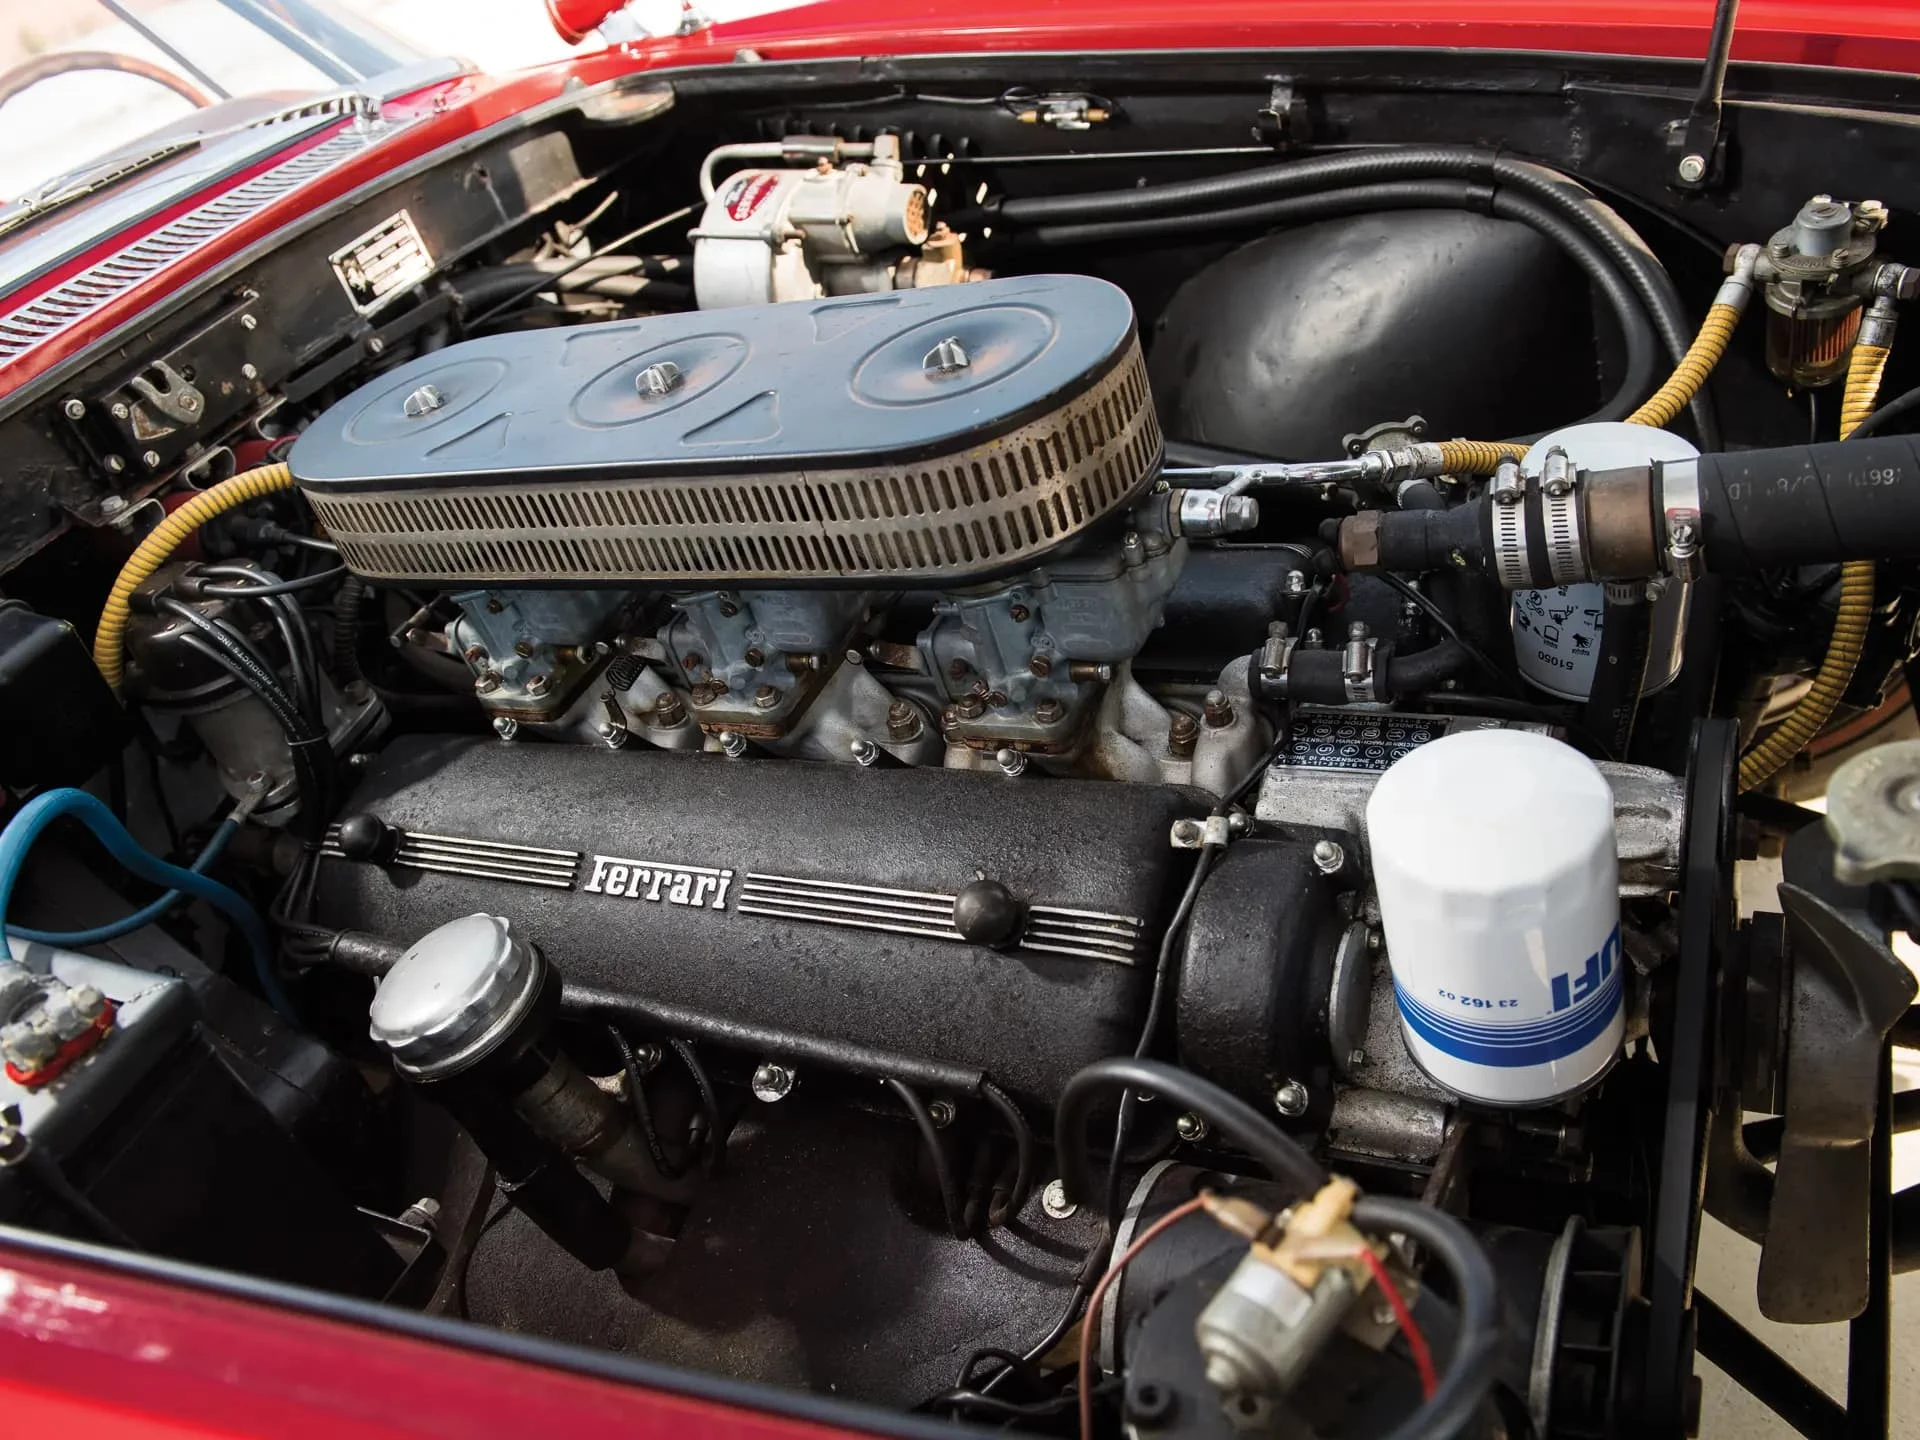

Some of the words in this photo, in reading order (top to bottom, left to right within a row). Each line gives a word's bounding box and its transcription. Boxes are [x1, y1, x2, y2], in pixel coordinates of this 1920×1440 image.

[232, 646, 274, 686] PRODUCTS
[1538, 651, 1575, 671] 51050
[584, 855, 733, 910] Ferrari
[1551, 919, 1620, 1013] UFI
[1438, 989, 1456, 1001] 02
[1460, 995, 1493, 1009] 162
[1499, 999, 1518, 1008] 23
